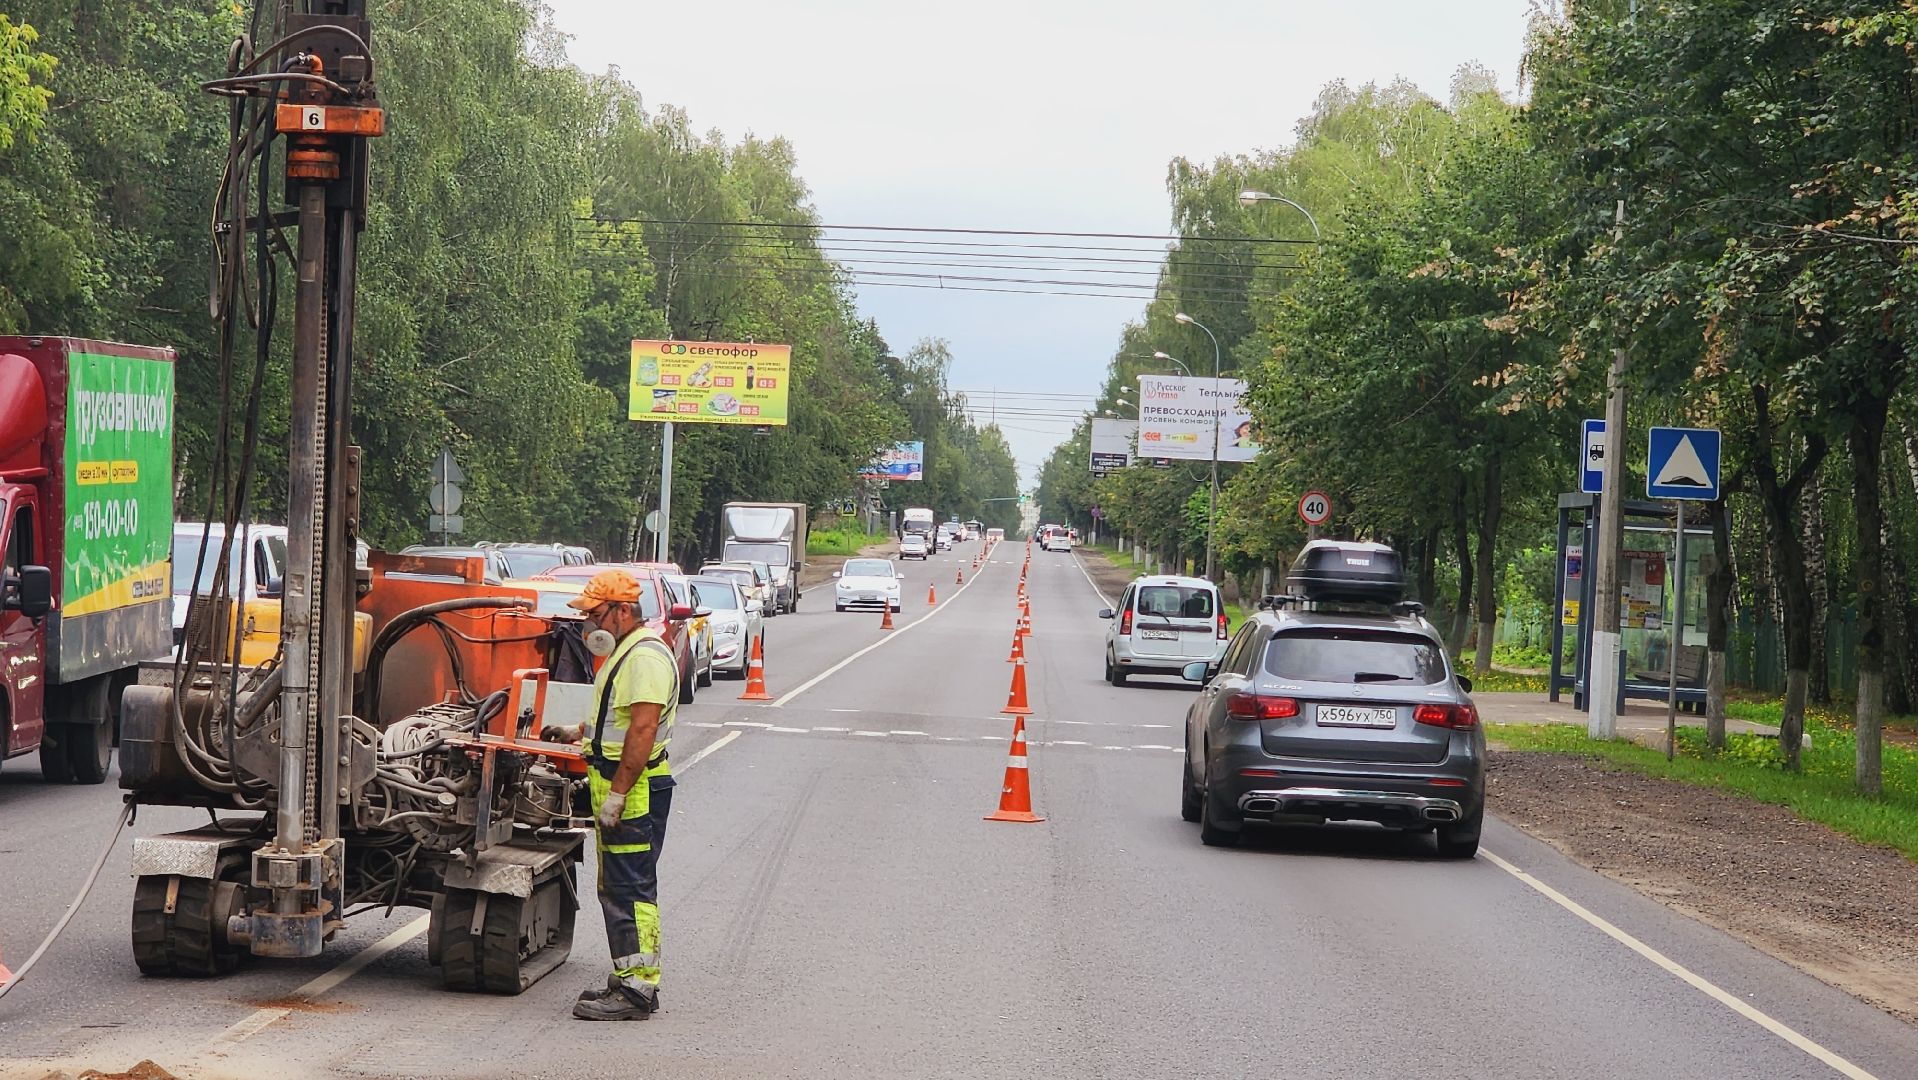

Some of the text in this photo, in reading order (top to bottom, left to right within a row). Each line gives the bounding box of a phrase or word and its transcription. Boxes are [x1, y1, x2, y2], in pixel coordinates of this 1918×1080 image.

[309, 113, 319, 125] 6
[690, 346, 758, 359] светофор
[1157, 381, 1186, 392] Русское
[1158, 392, 1178, 400] тепло
[1143, 406, 1227, 418] ПРЕВОСХОДНЫЙ
[1306, 502, 1323, 514] 40
[84, 498, 138, 540] 150-00-00
[1346, 558, 1370, 566] THULE
[1373, 709, 1392, 720] 750
